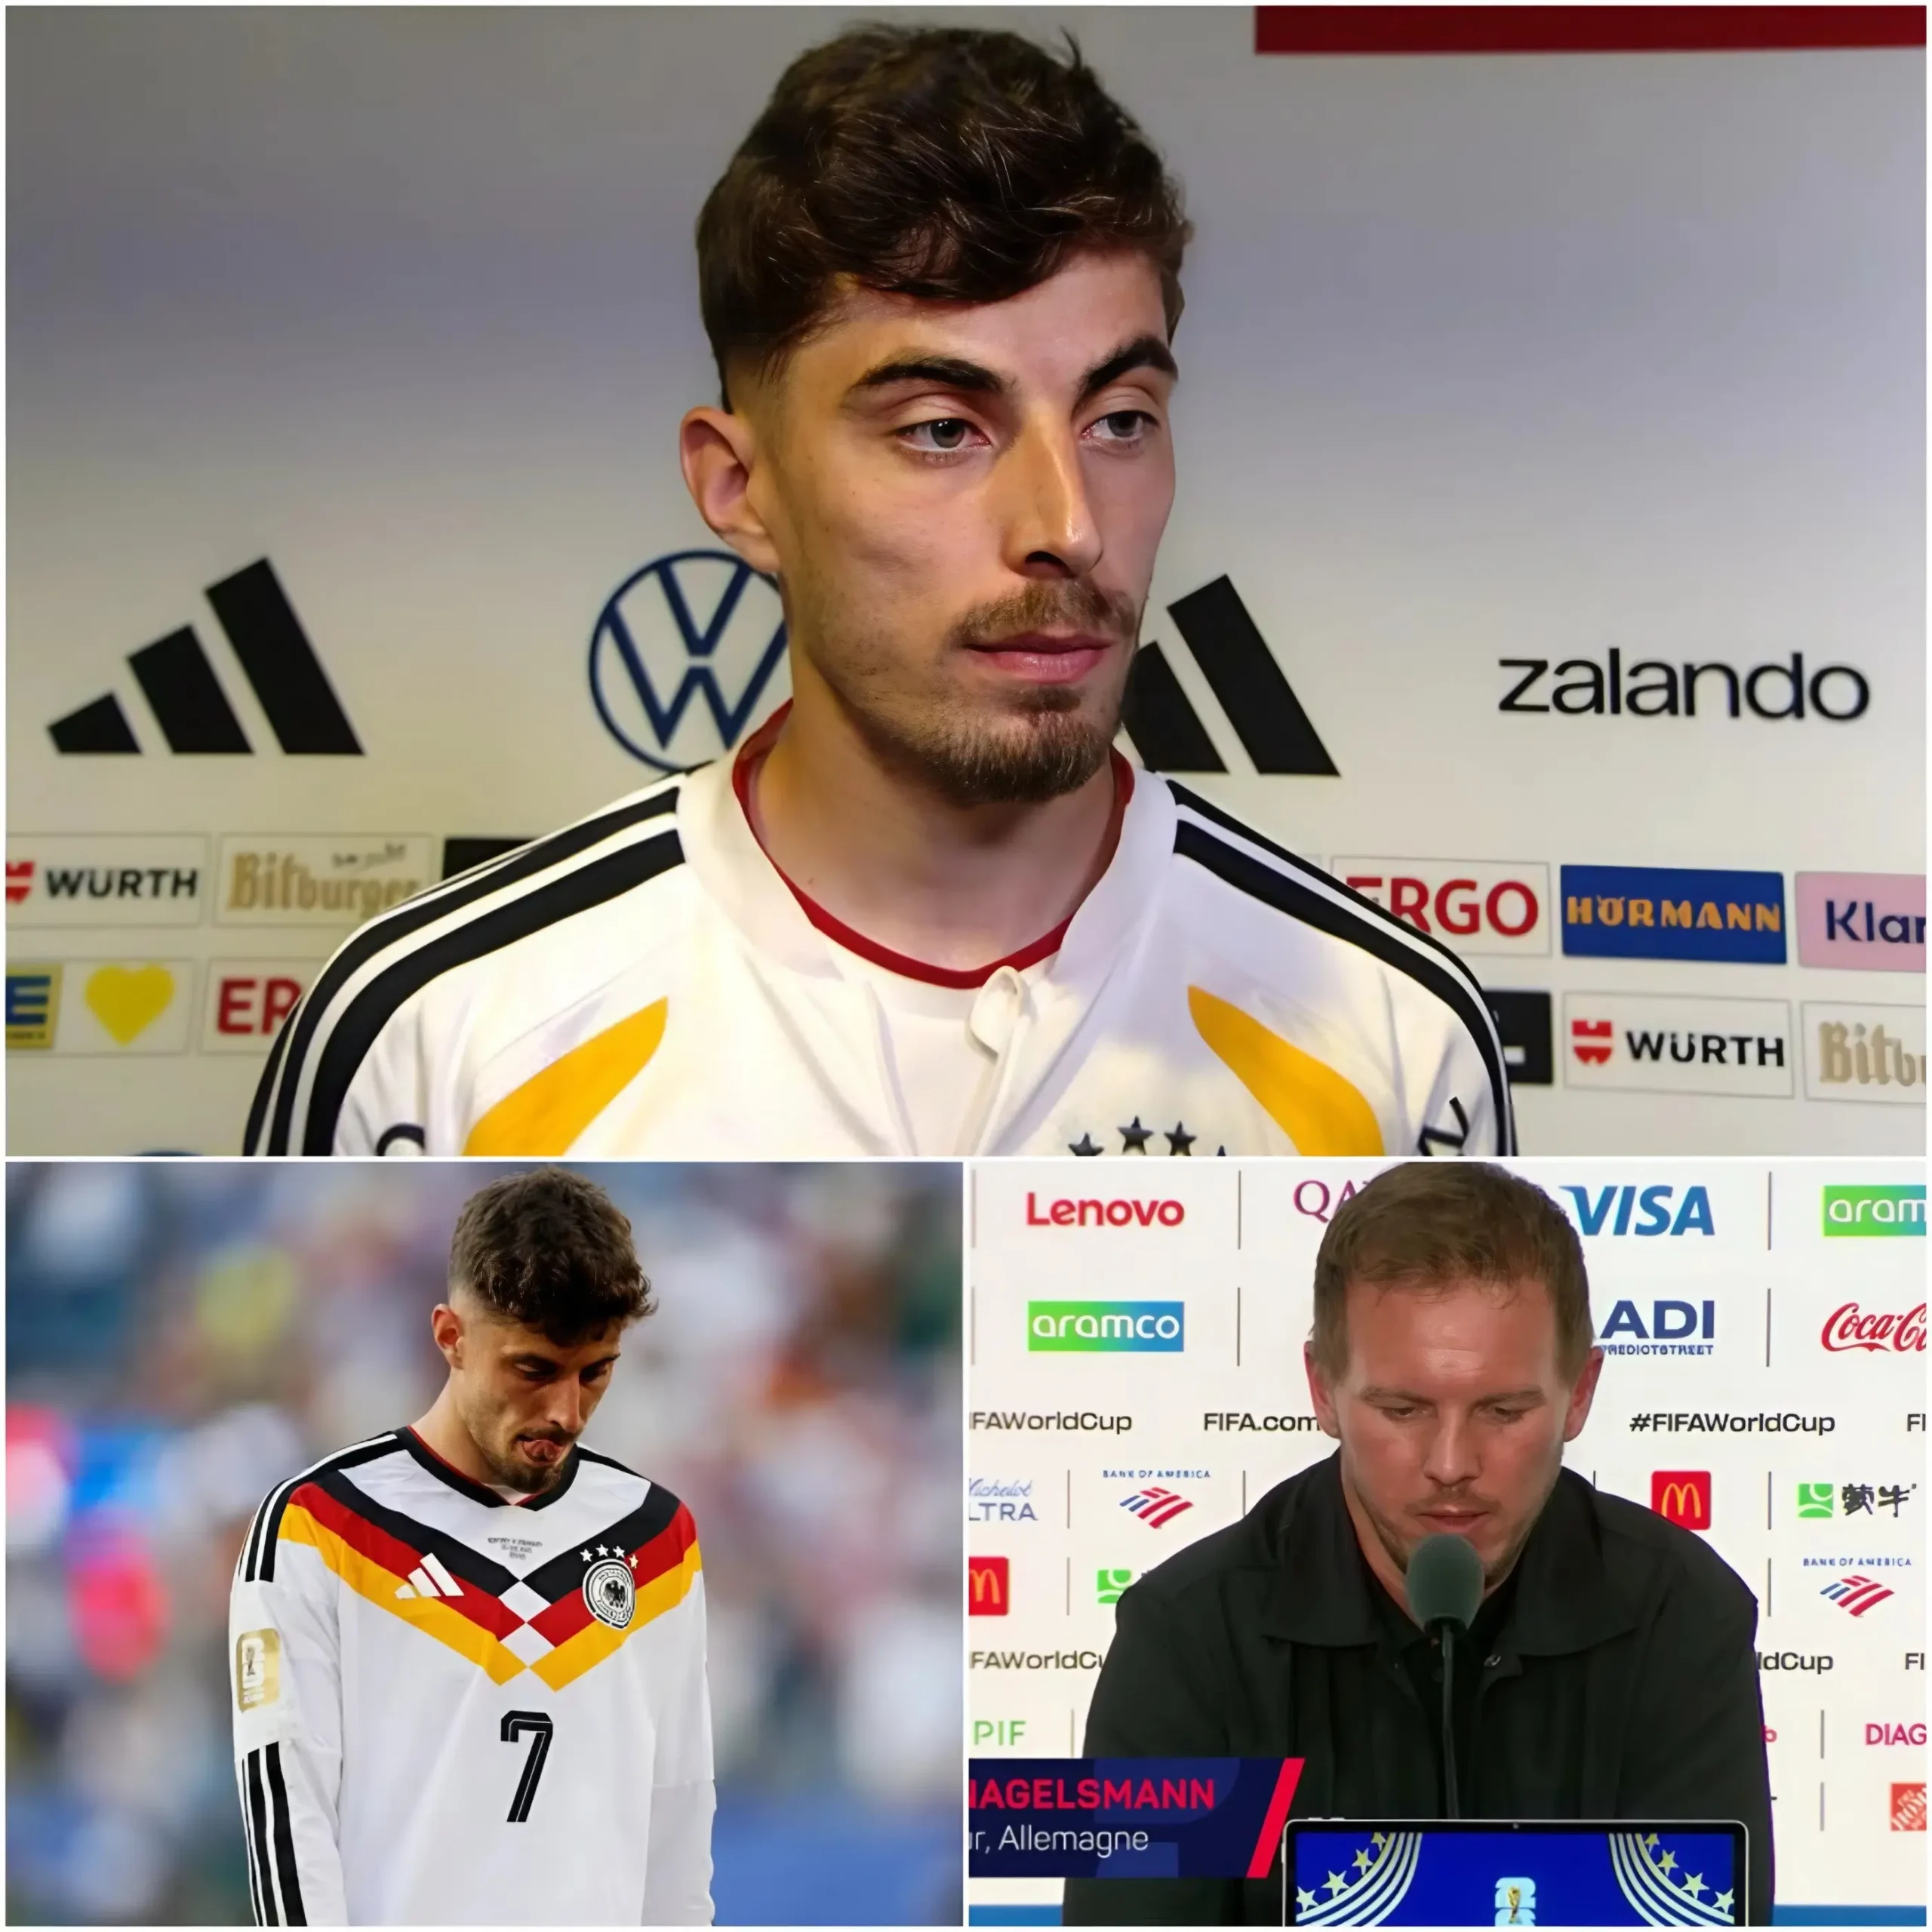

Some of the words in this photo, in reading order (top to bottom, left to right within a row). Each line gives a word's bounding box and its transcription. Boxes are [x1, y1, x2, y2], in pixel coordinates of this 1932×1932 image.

[1499, 648, 1869, 721] zalando
[1346, 877, 1539, 937] RGO
[1567, 894, 1781, 931] HÖRMANN
[1027, 1192, 1185, 1226] Lenovo
[1558, 1186, 1715, 1236] VISA
[1032, 1315, 1180, 1339] aramco
[1600, 1300, 1715, 1339] ADI
[1204, 1413, 1320, 1431] FIFA.com
[1629, 1414, 1835, 1435] #FIFAWorldCup
[974, 1721, 1026, 1746] PIF
[500, 1710, 554, 1823] 7
